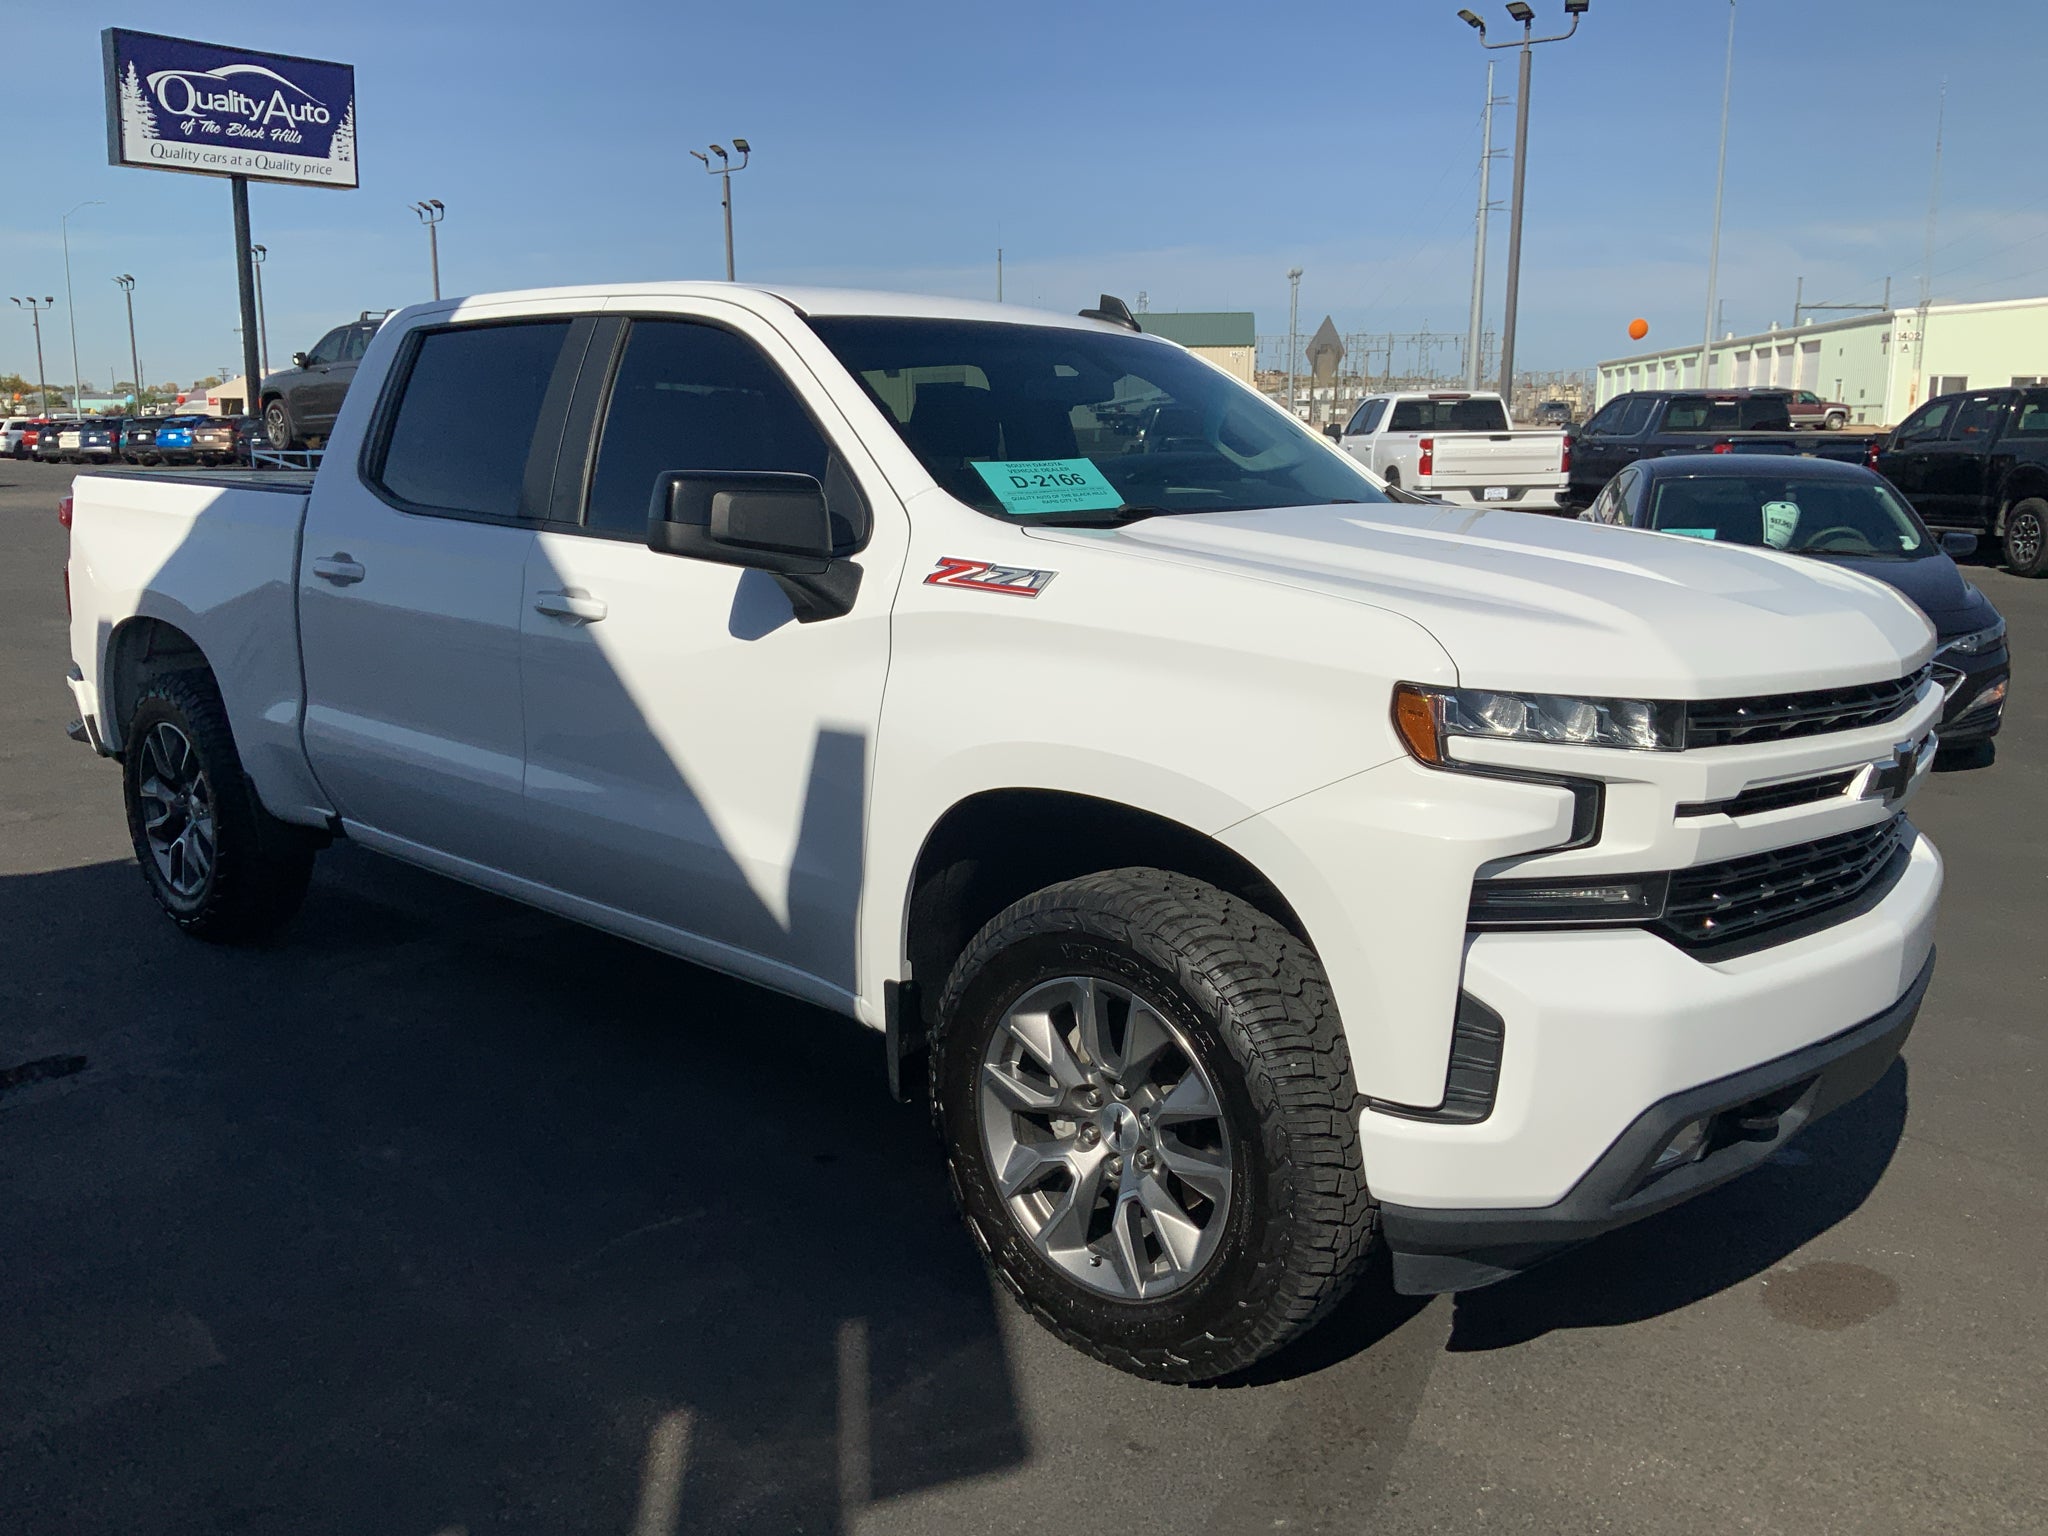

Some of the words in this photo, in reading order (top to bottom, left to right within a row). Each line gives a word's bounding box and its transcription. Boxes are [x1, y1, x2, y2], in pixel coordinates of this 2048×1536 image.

[181, 118, 196, 136] of
[199, 119, 221, 134] The
[226, 122, 265, 139] Black
[270, 128, 303, 144] Hills
[150, 142, 200, 163] Quality
[203, 153, 227, 164] cars
[230, 154, 242, 166] at
[245, 157, 252, 166] a
[255, 154, 301, 175] Quality
[303, 162, 333, 176] price
[1009, 473, 1086, 488] D-2166
[922, 556, 1059, 600] Z71
